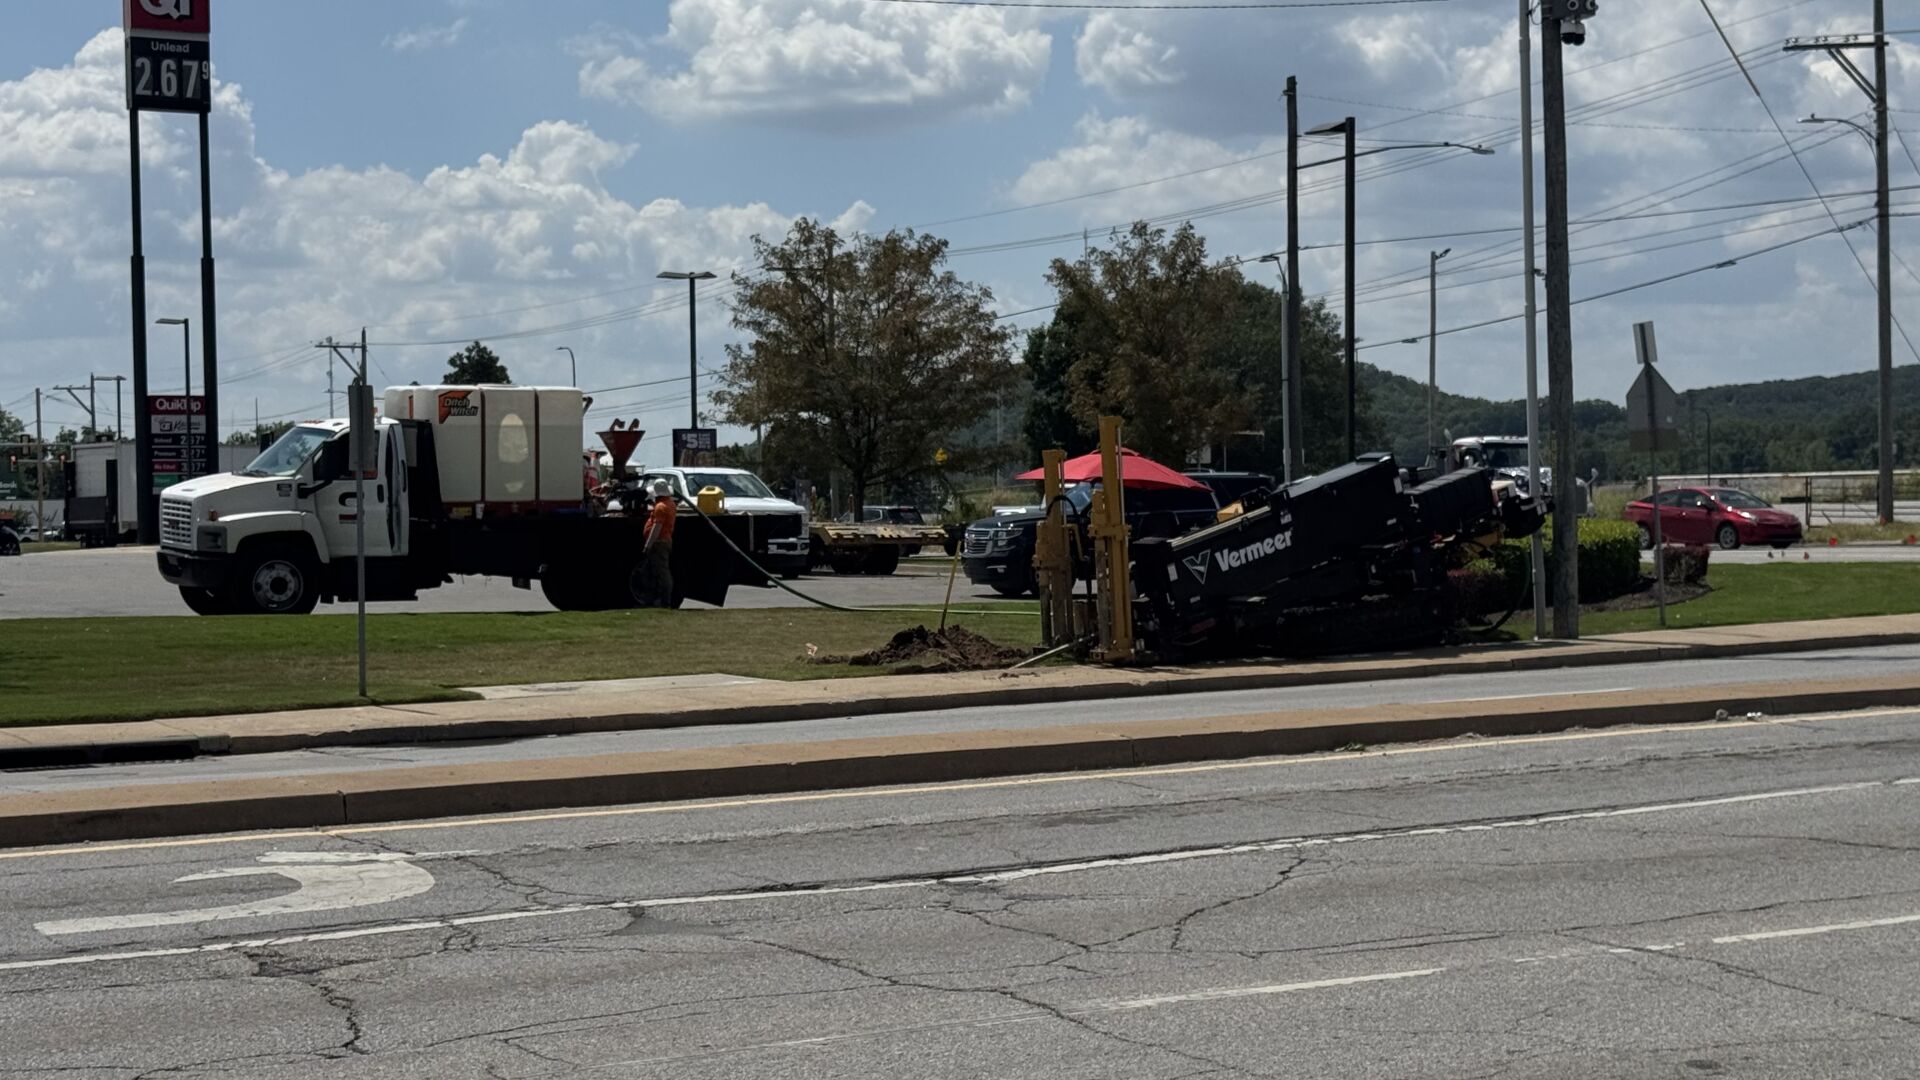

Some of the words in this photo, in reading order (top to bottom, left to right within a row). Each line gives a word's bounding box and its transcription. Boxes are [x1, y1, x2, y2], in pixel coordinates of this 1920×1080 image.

[150, 40, 190, 53] Unlead
[156, 398, 201, 412] QuikTip
[444, 398, 470, 407] Ditch
[450, 406, 478, 416] Witch
[1214, 530, 1292, 572] Vermeer
